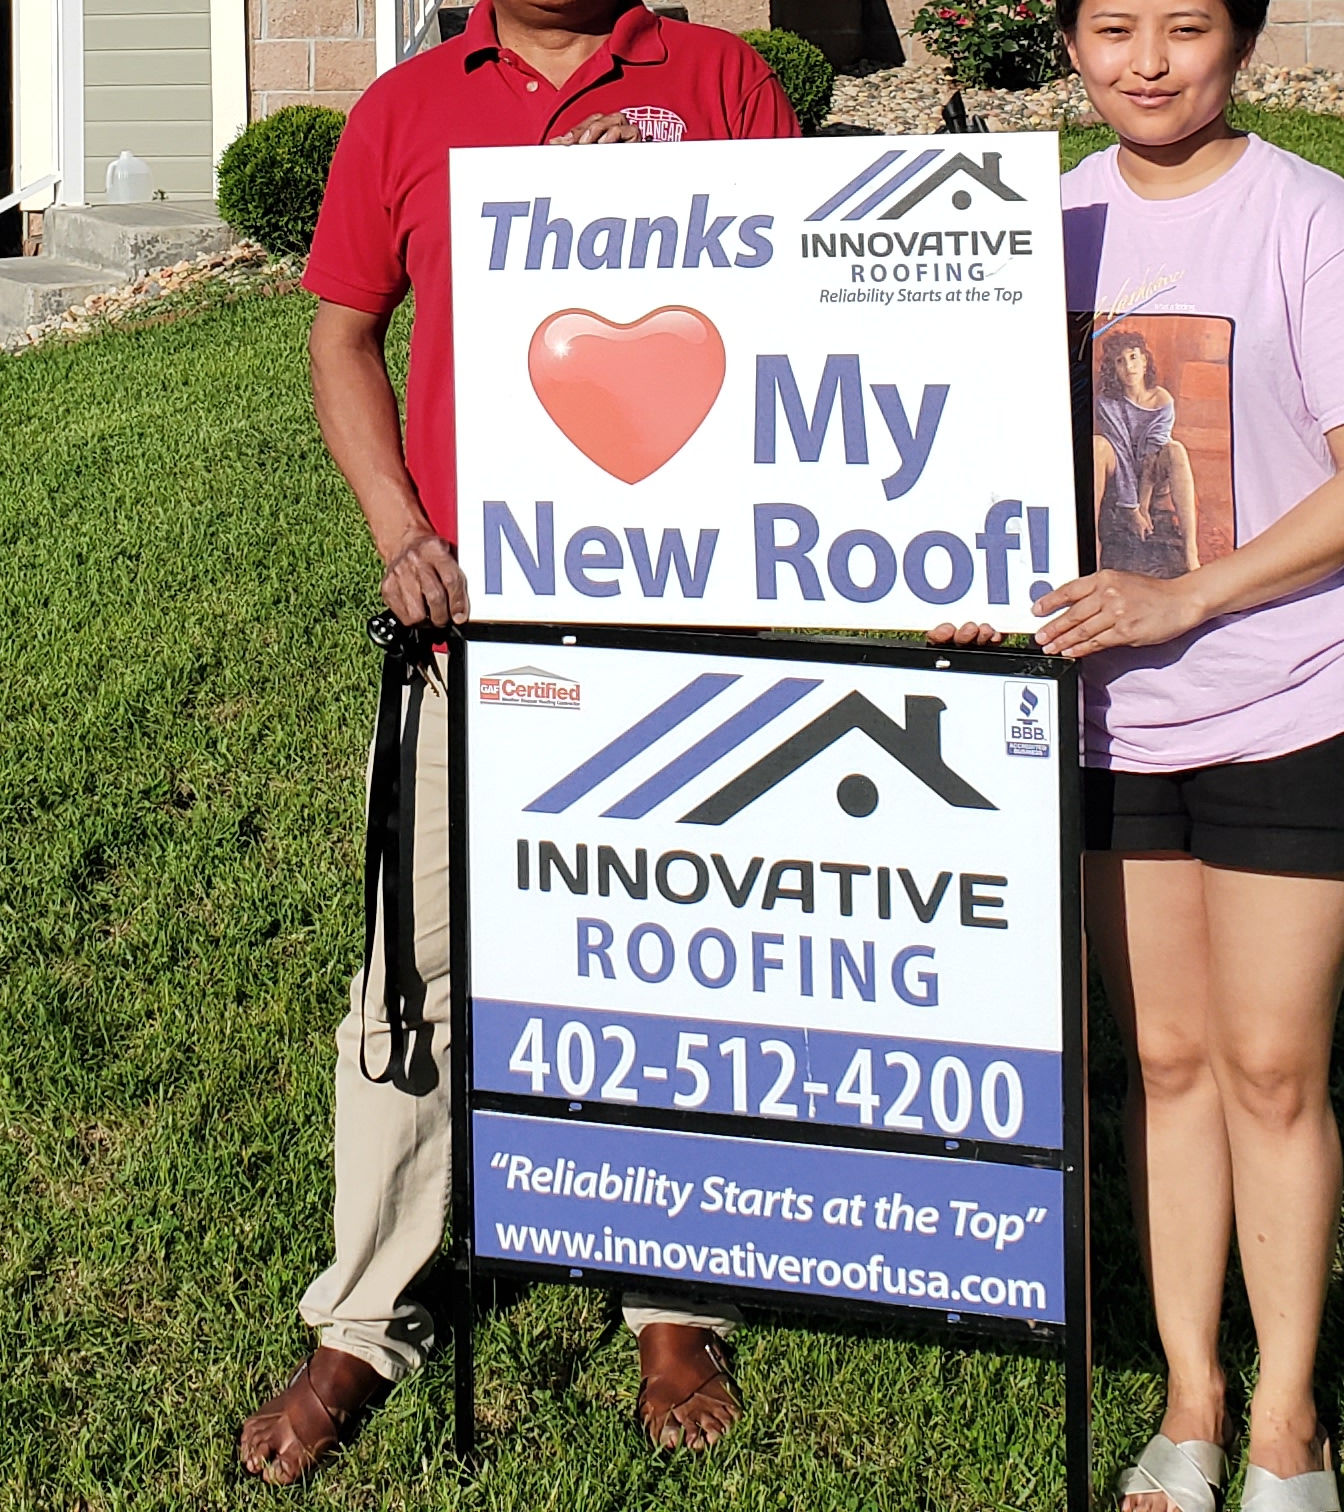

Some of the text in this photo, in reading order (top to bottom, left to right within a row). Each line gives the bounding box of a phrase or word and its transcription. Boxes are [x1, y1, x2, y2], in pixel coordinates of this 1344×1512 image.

[480, 194, 774, 271] Thanks
[801, 230, 1033, 258] INNOVATIVE
[851, 263, 985, 283] ROOFING
[820, 287, 1023, 305] Reliability Starts at the Top
[753, 354, 950, 501] My
[482, 498, 1054, 606] New Roof!
[481, 684, 500, 694] GAF
[502, 679, 580, 702] Certified
[1011, 726, 1045, 740] BBB
[517, 839, 1009, 930] INNOVATIVE
[576, 917, 940, 1007] ROOFING
[509, 1018, 1024, 1139] 402-512-4200
[490, 1153, 1048, 1251] “Reliability Starts at the Top”
[495, 1222, 1047, 1310] www.innovativeroofusa.com
